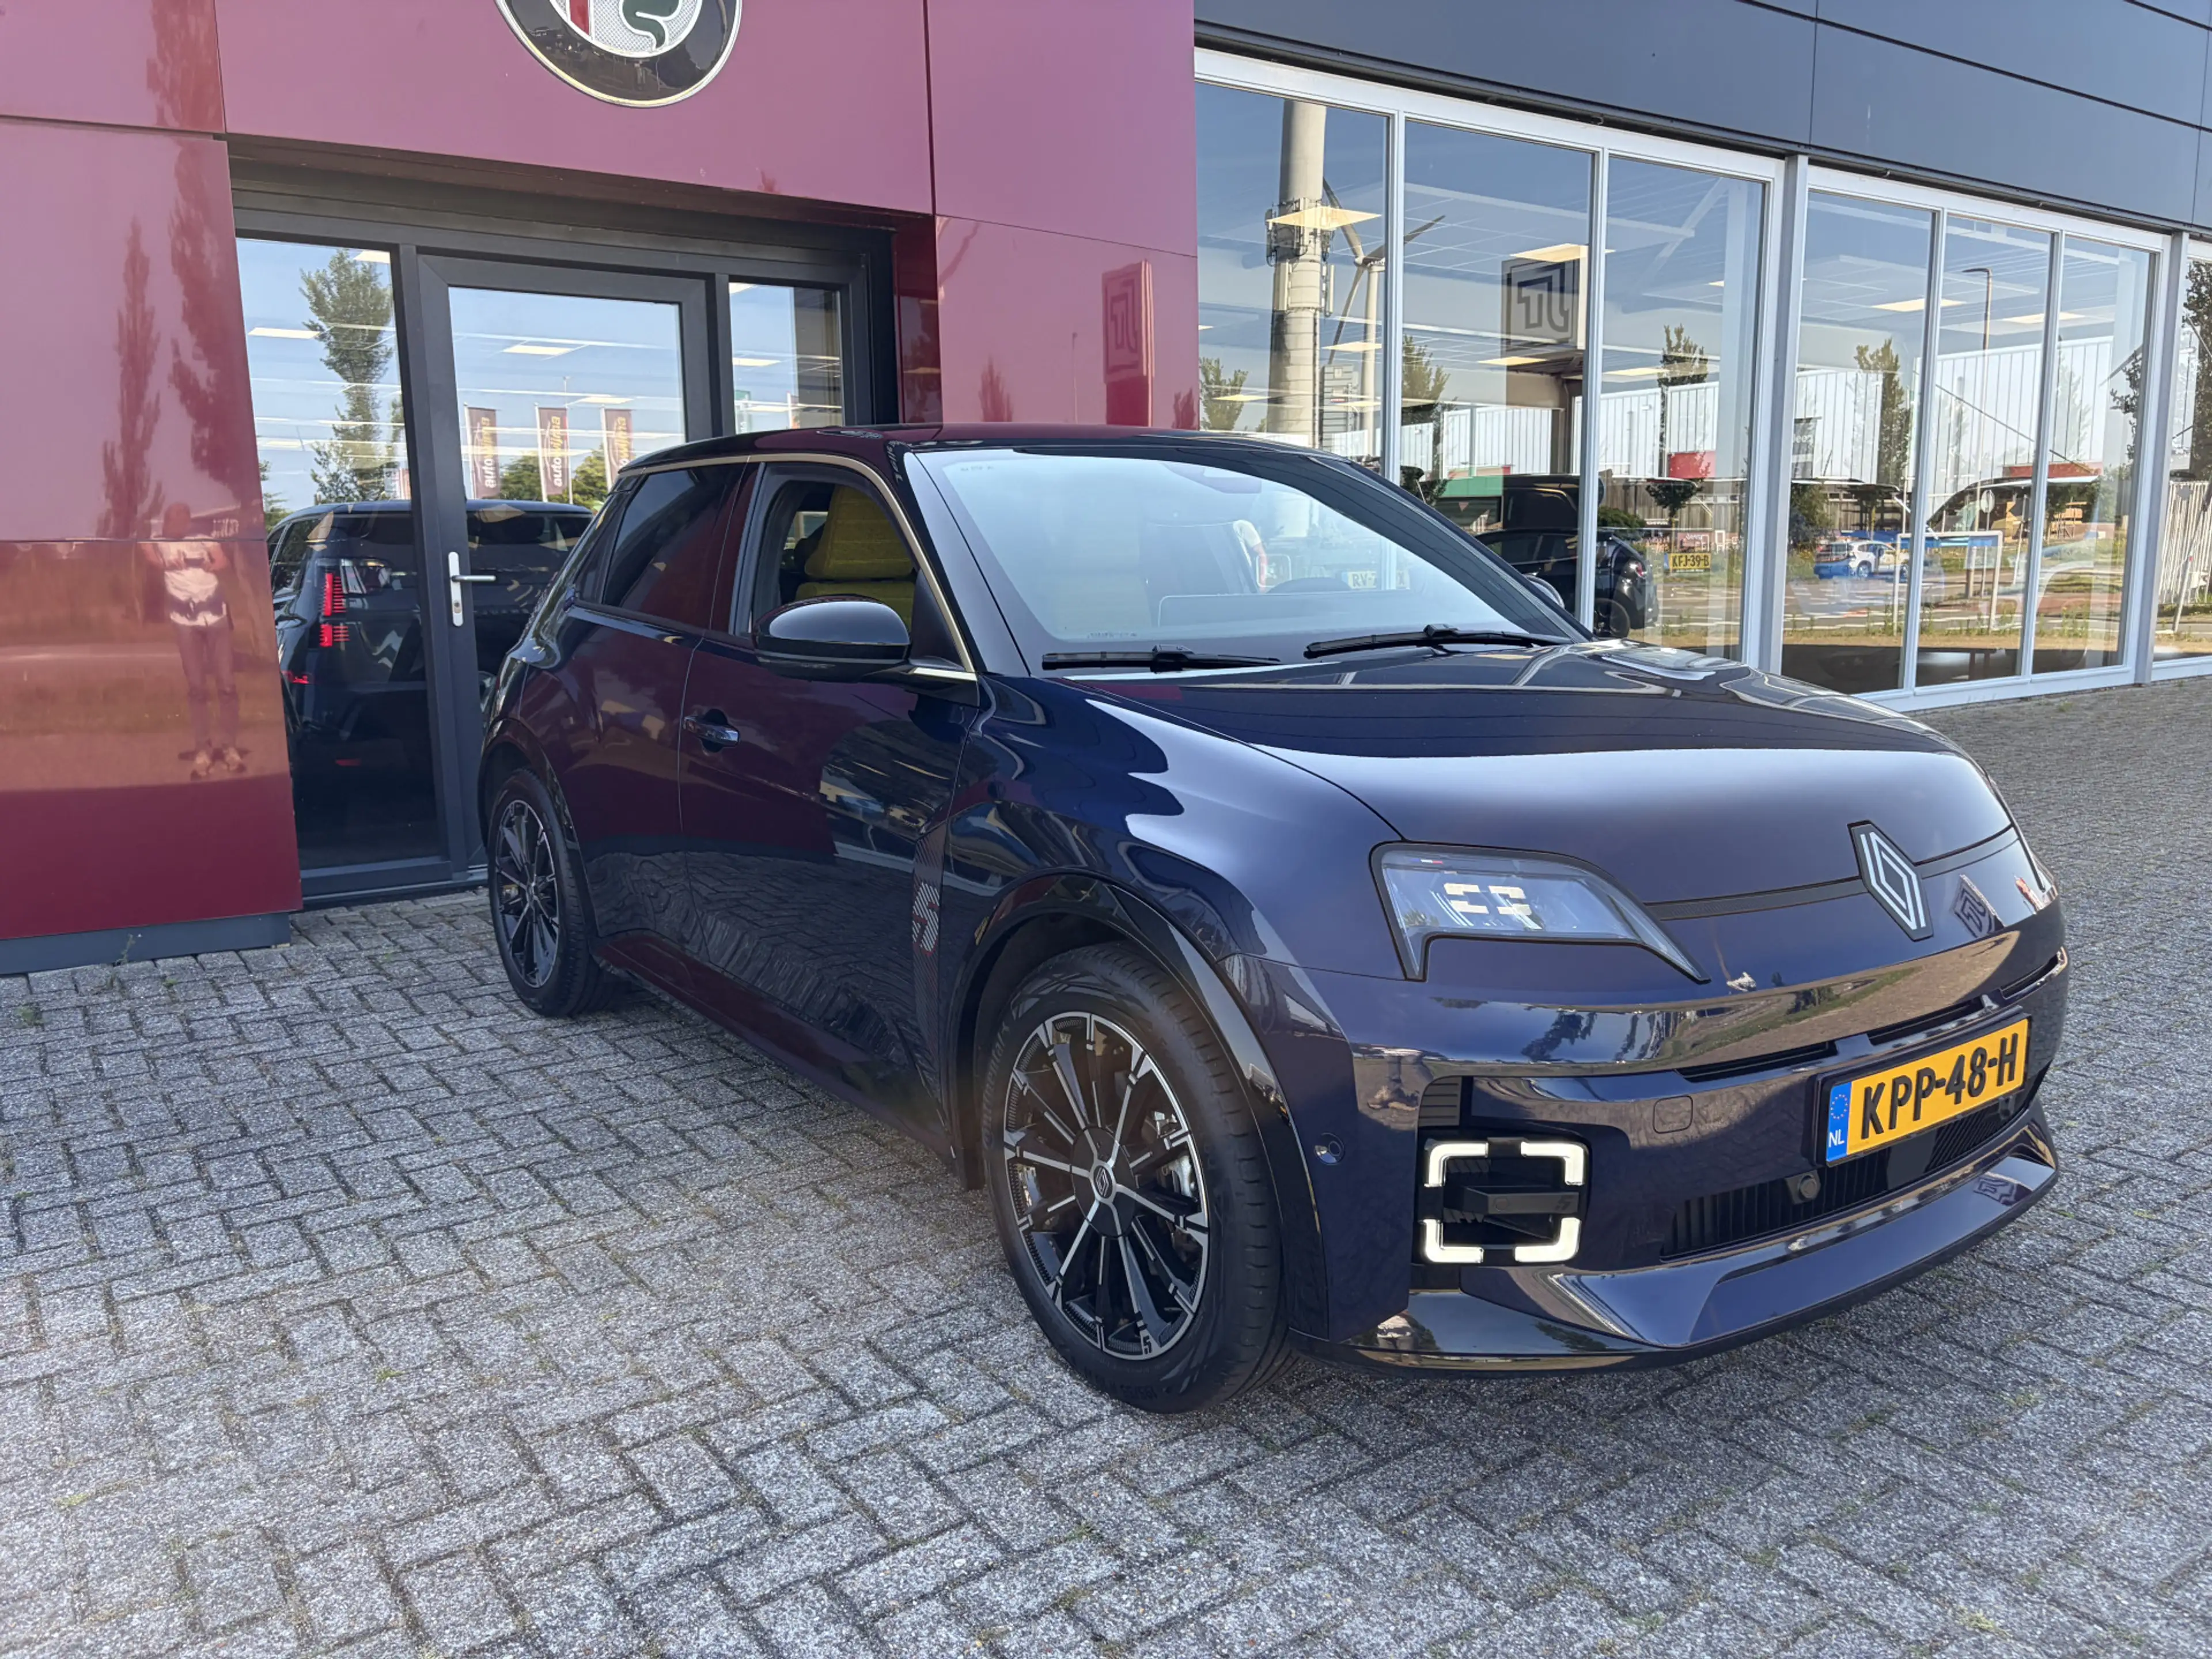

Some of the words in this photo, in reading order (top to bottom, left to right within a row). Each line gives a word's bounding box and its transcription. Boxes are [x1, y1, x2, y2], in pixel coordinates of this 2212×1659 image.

[550, 416, 563, 487] autowijma
[1673, 554, 1709, 567] KFJ-39-B
[1861, 1033, 2018, 1139] KPP-48-H
[1828, 1128, 1845, 1148] NL
